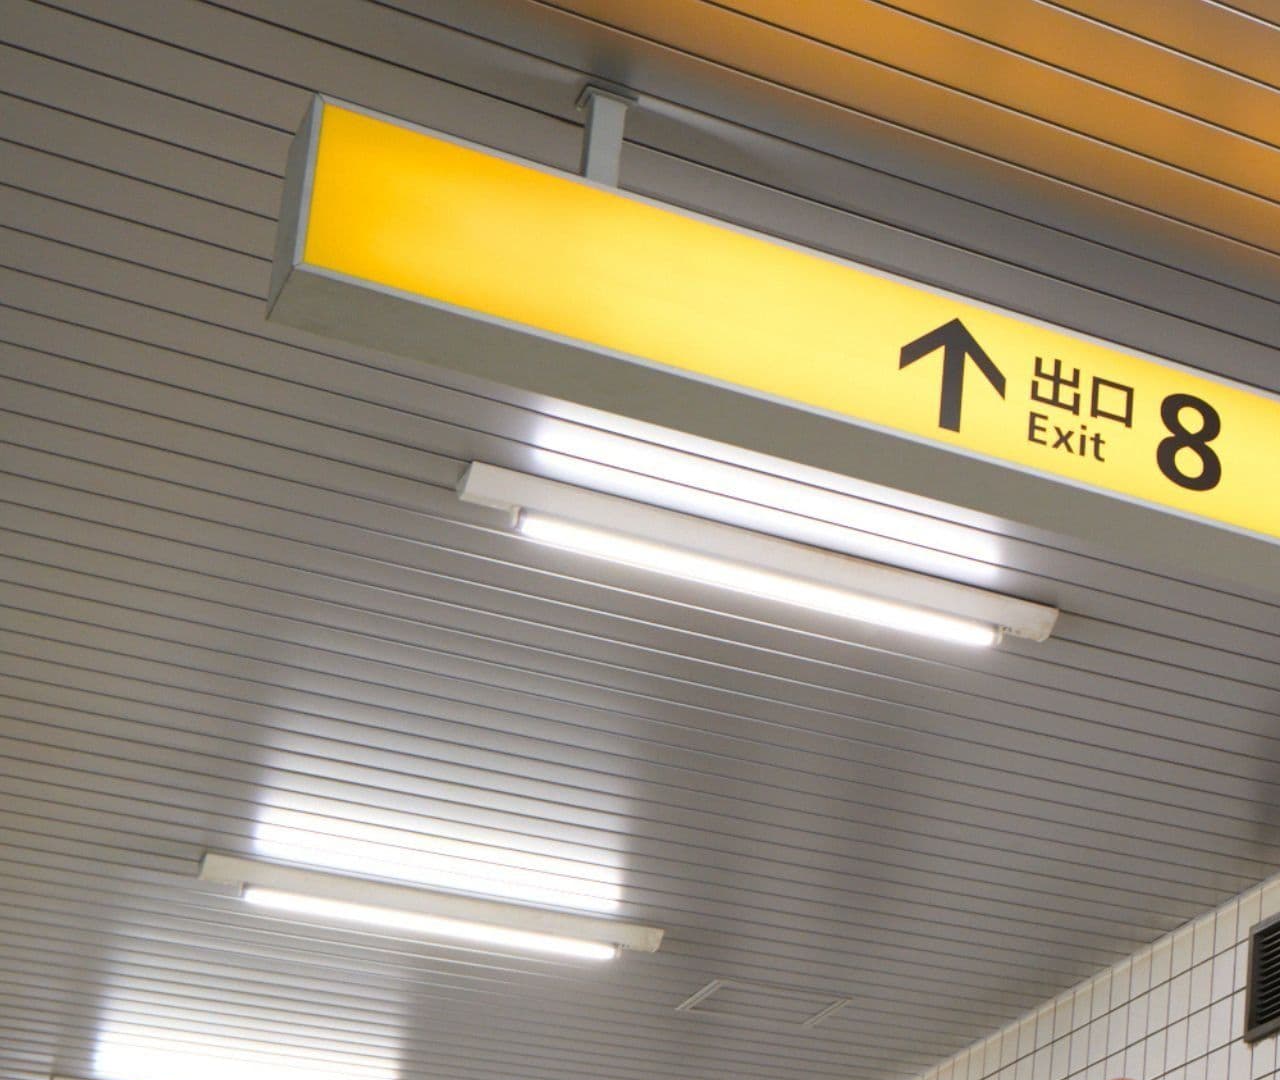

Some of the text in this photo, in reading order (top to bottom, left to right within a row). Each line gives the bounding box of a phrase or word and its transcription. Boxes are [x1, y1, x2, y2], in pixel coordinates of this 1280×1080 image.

[1030, 356, 1134, 428] 出口
[1027, 411, 1106, 462] Exit
[1156, 393, 1222, 491] 8
